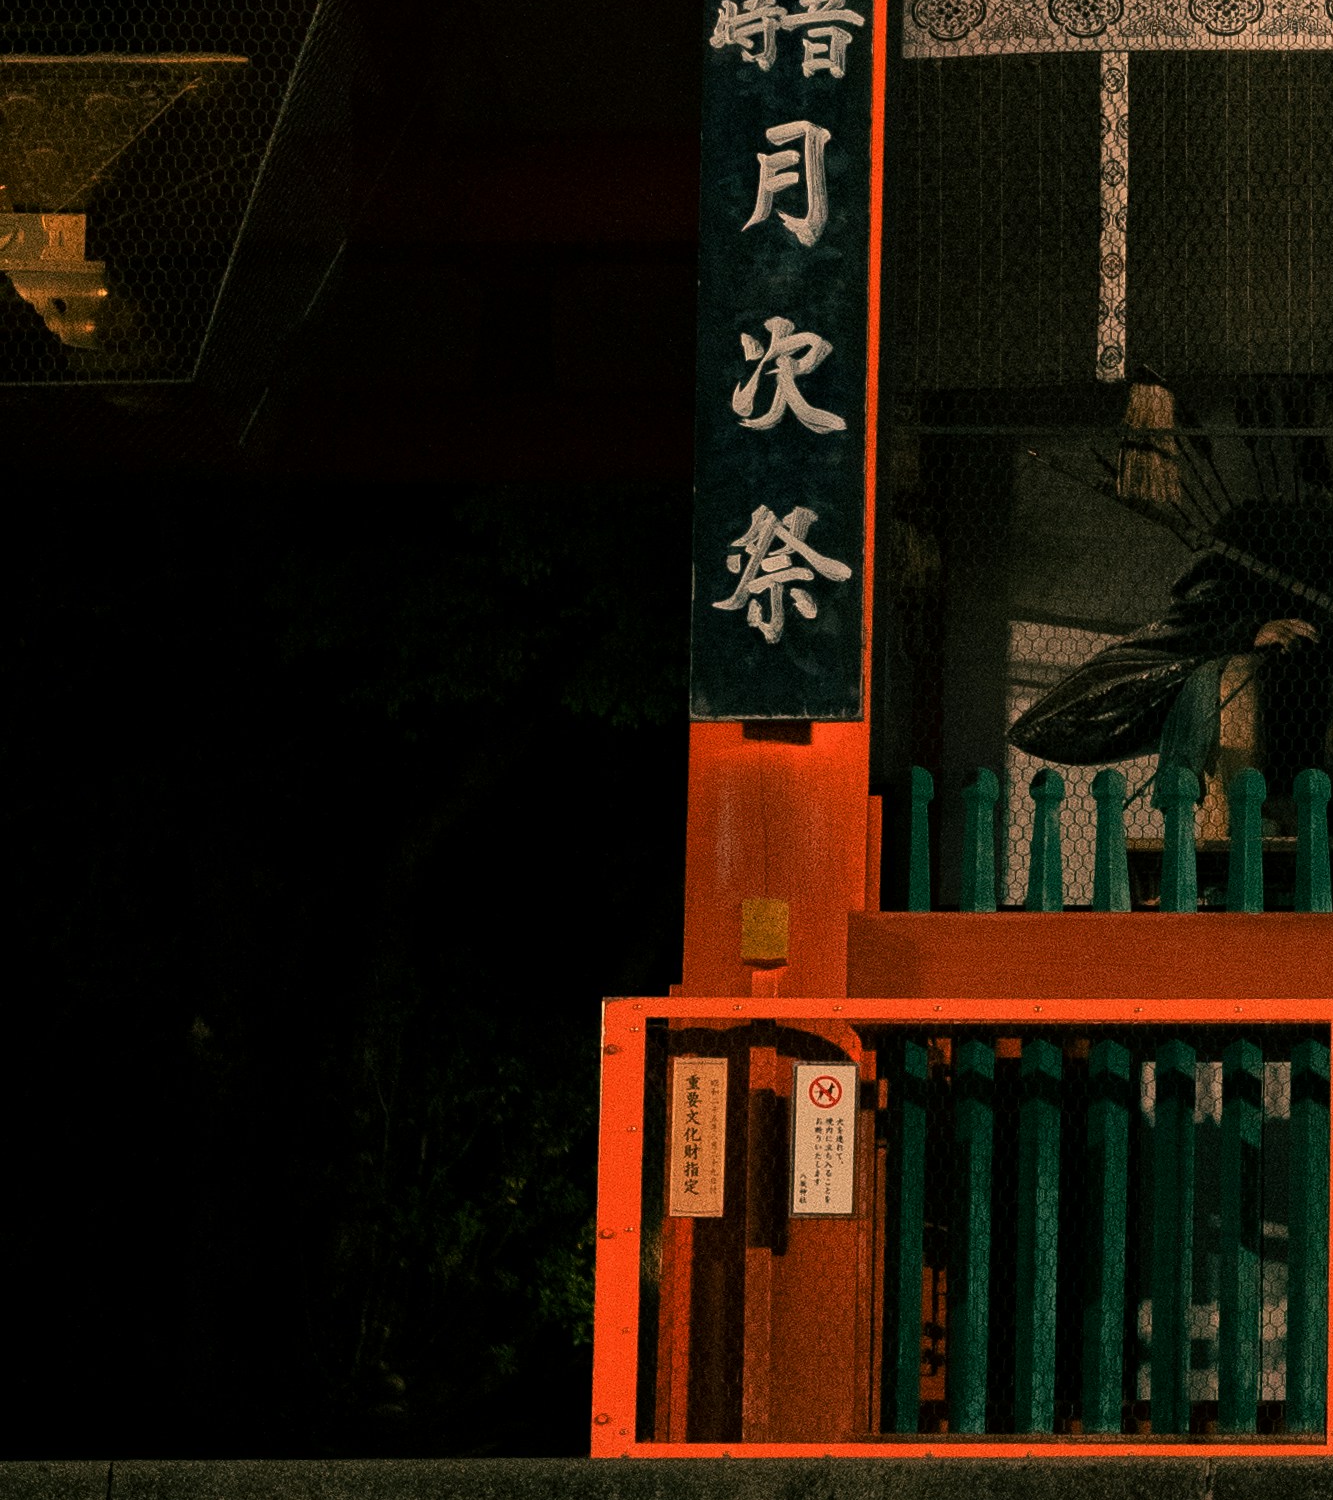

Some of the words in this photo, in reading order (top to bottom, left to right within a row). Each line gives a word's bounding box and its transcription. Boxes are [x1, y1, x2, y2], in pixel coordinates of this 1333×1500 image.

[712, 120, 852, 643] 月次祭
[683, 1074, 702, 1196] 重要文化財指定
